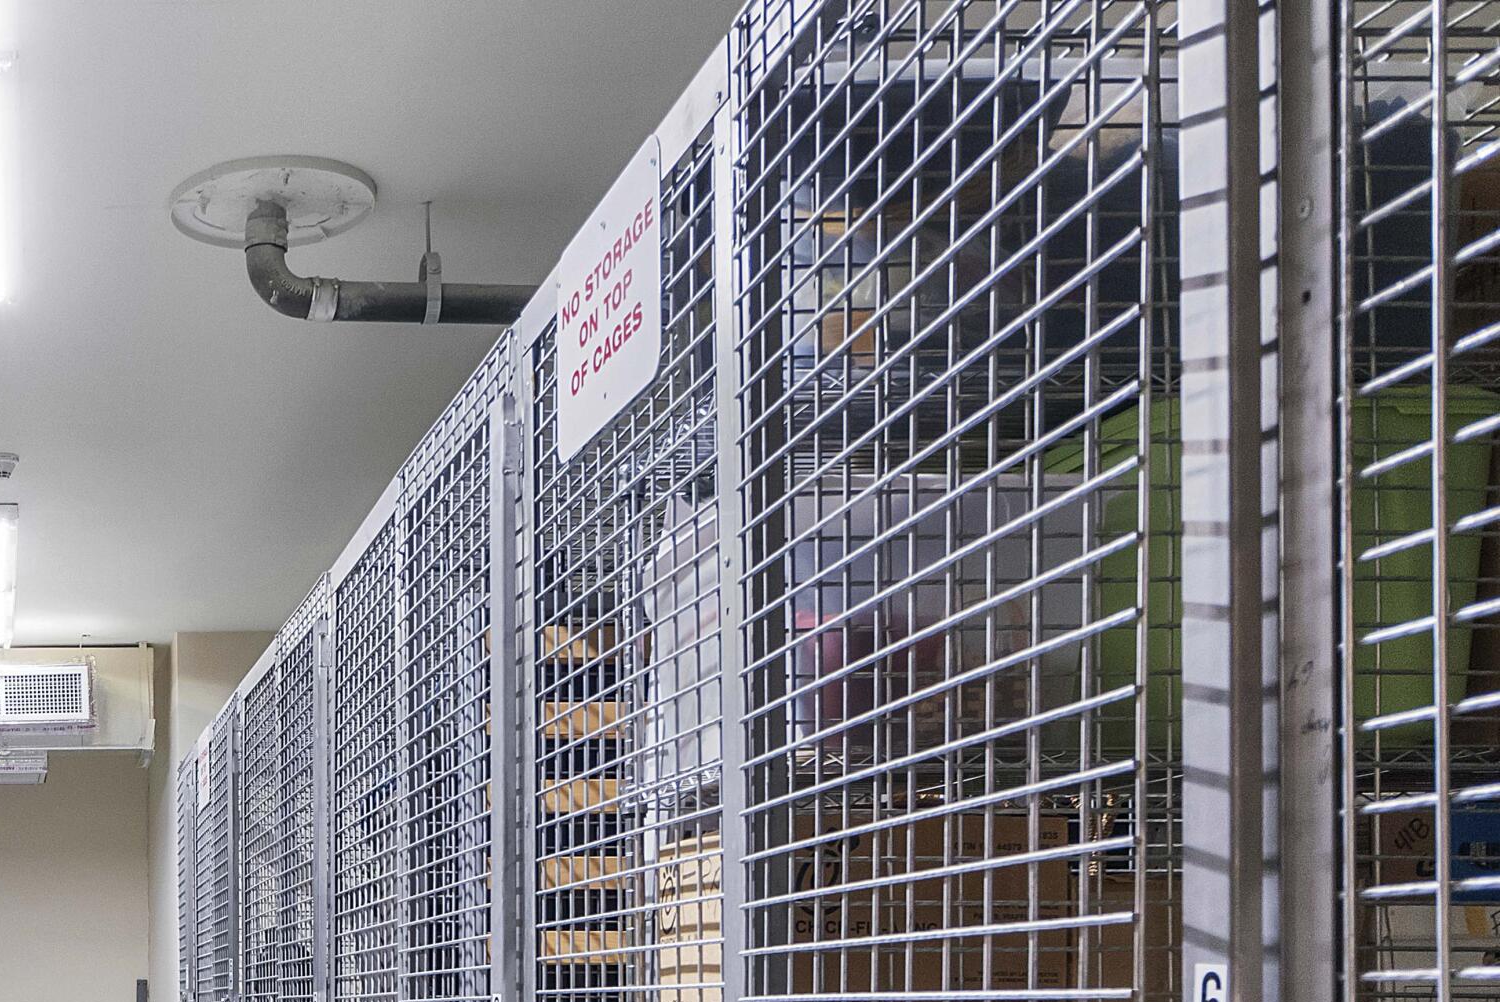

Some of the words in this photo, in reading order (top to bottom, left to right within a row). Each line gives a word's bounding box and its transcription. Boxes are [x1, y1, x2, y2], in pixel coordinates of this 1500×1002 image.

[561, 291, 581, 330] NO
[585, 197, 654, 293] STORAGE
[579, 308, 599, 348] ON
[603, 269, 633, 321] TOP
[571, 360, 589, 397] OF
[592, 301, 644, 373] CAGES
